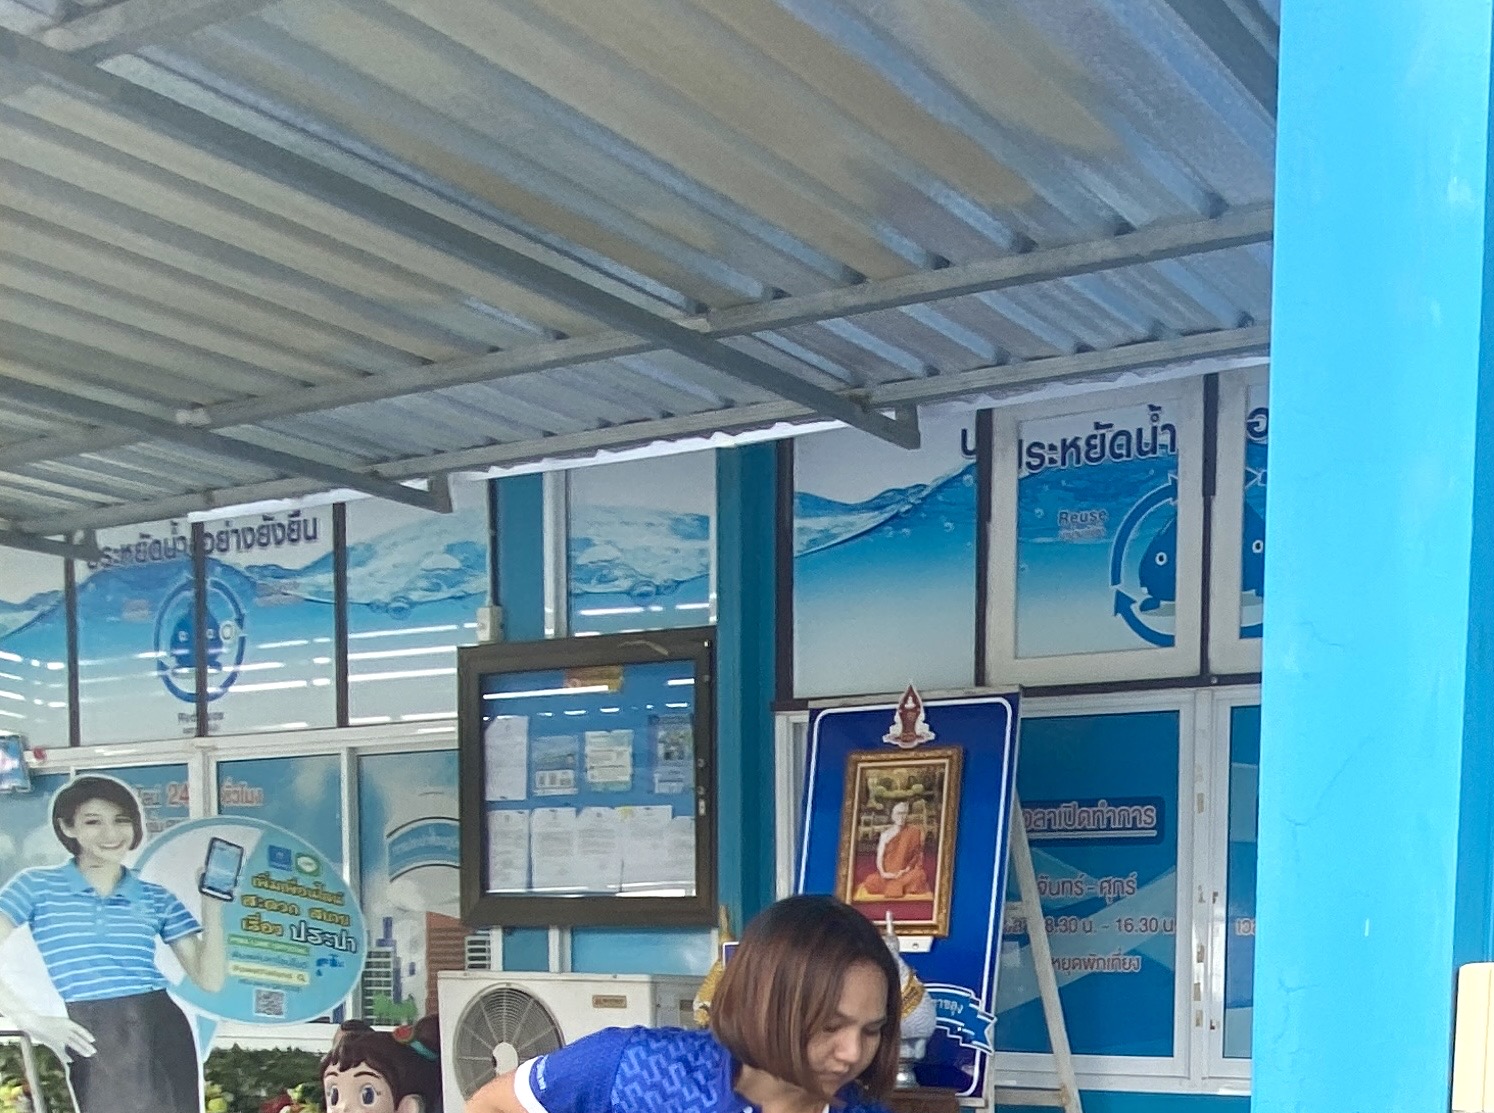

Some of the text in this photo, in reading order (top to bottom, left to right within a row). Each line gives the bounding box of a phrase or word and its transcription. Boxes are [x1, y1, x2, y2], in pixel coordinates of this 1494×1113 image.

[1024, 800, 1156, 830] วลาเปิดทำการ
[1115, 916, 1159, 934] 16.30
